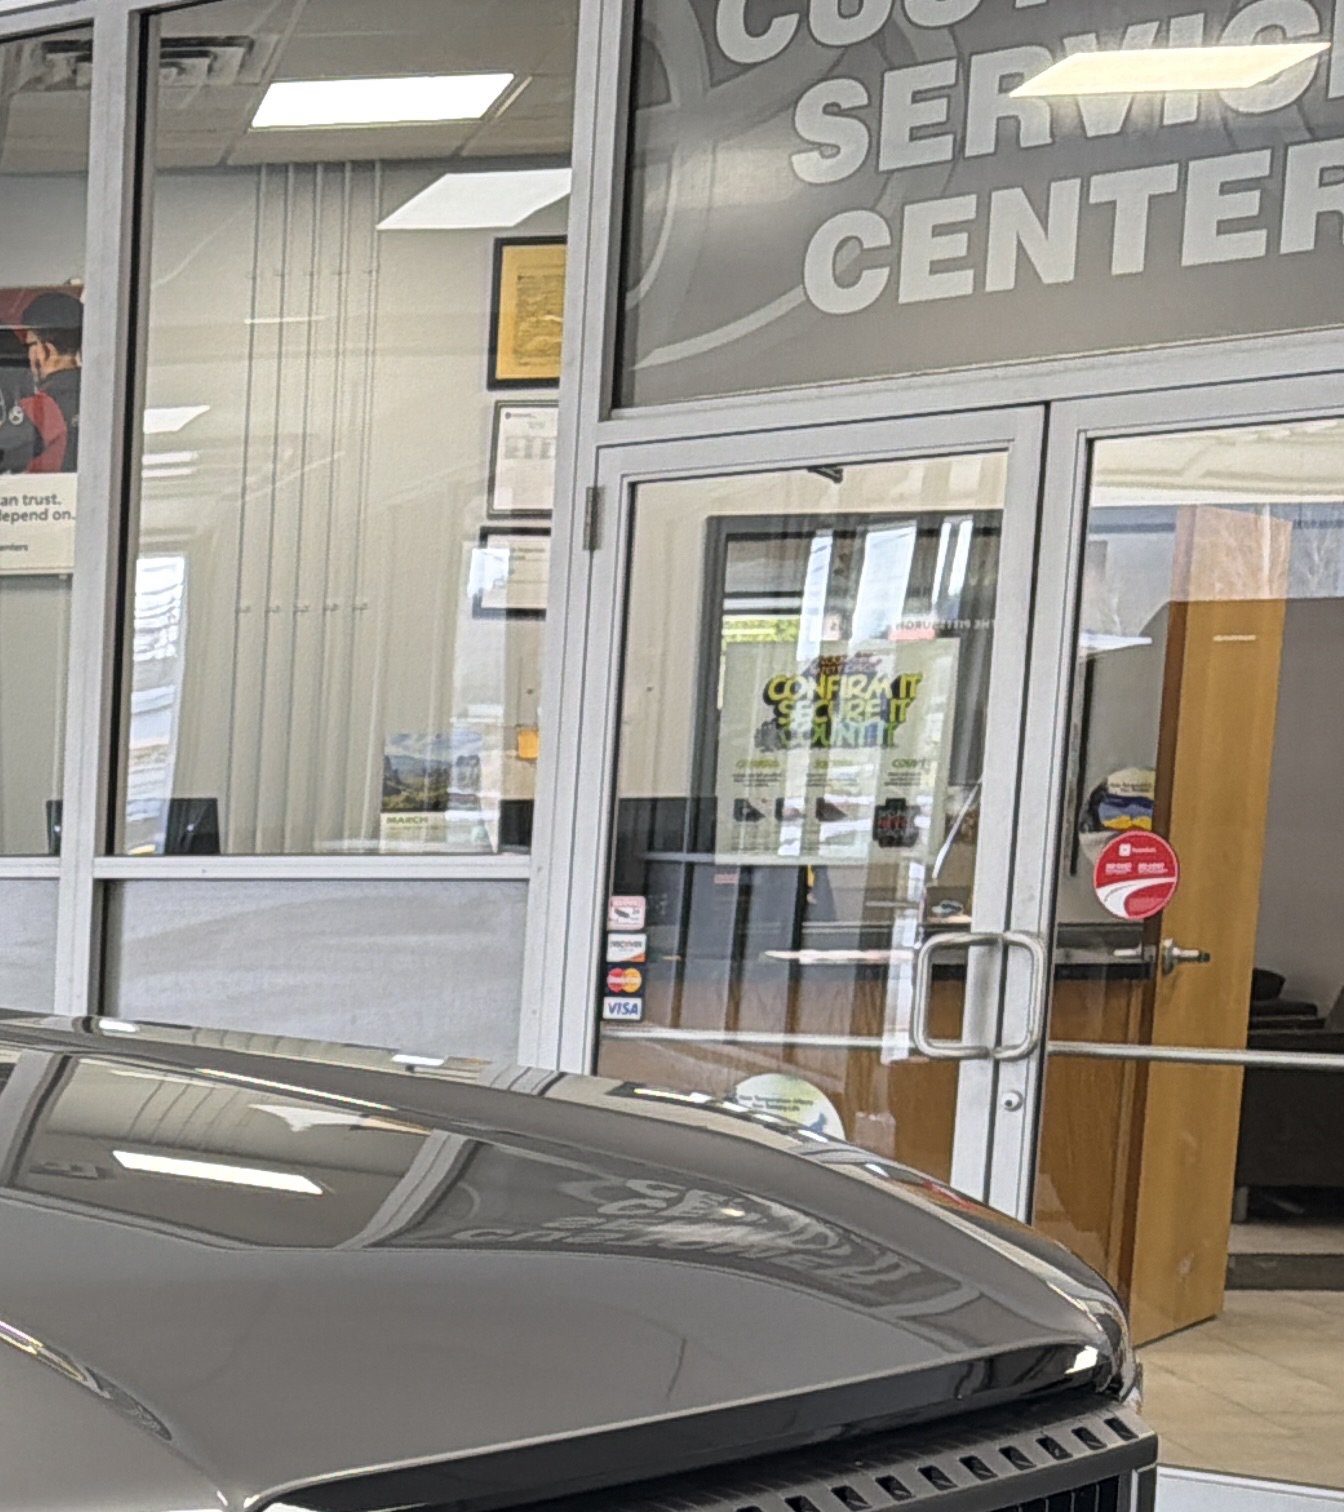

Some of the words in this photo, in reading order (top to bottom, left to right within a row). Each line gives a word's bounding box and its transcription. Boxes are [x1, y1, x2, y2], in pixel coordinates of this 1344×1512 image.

[791, 0, 1344, 184] SERVIC
[803, 138, 1344, 315] CENTER
[22, 494, 62, 506] trust.
[52, 510, 76, 521] on.
[766, 674, 891, 701] CONFIRM
[897, 673, 922, 699] IT
[777, 698, 882, 727] SECURE
[889, 698, 911, 722] IT
[386, 816, 428, 825] MARCH
[608, 1002, 639, 1015] VISA
